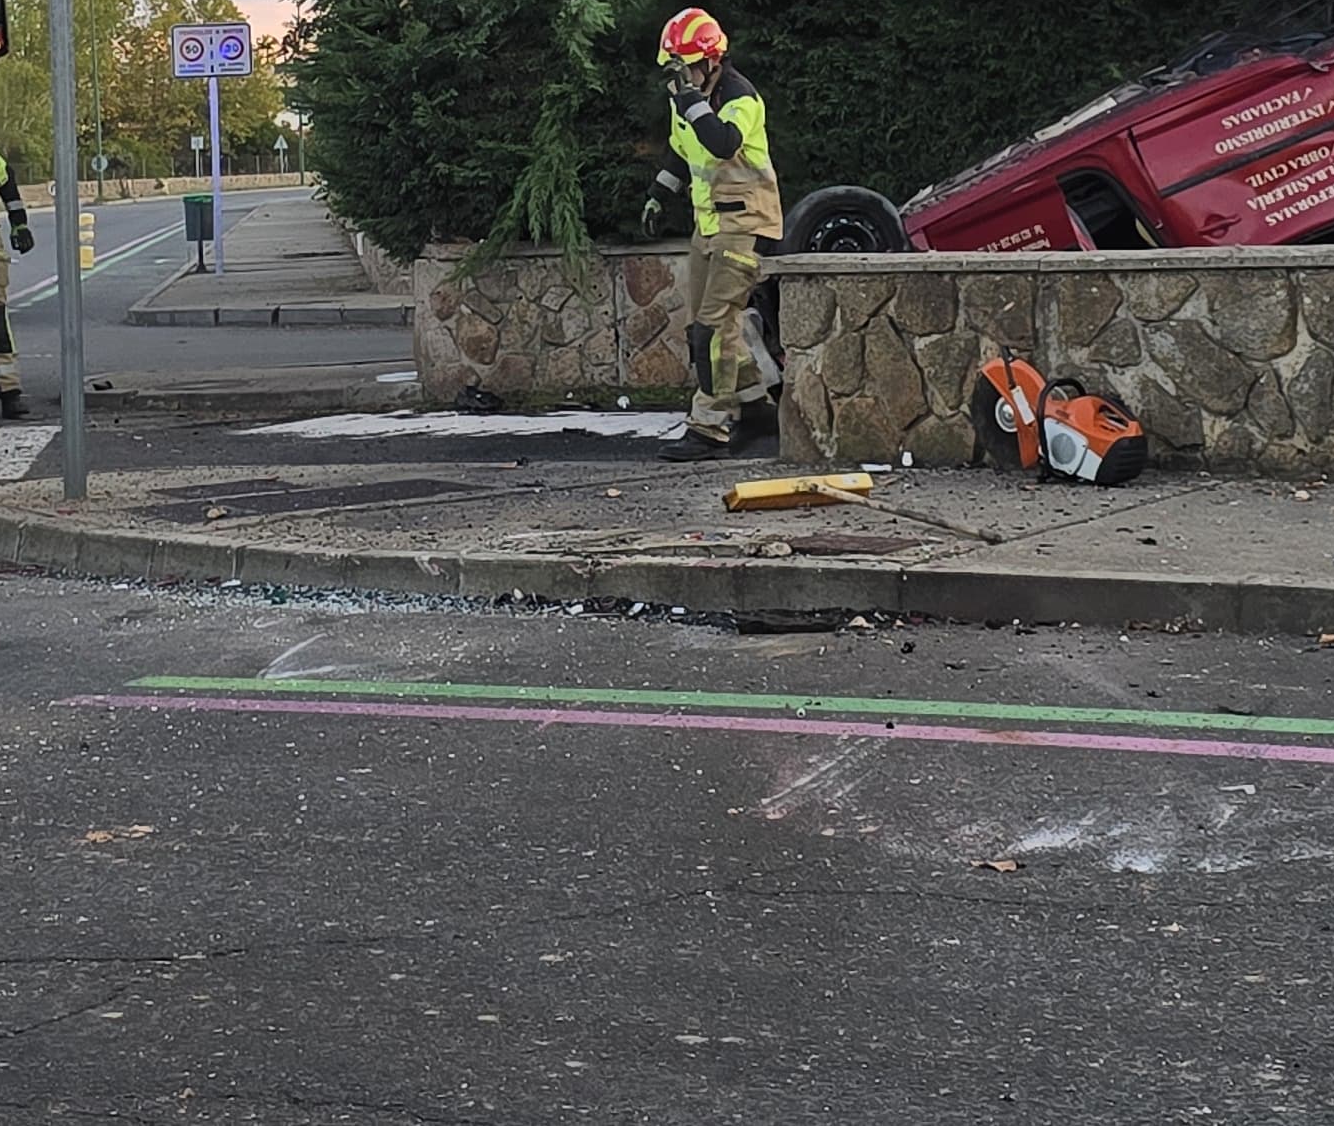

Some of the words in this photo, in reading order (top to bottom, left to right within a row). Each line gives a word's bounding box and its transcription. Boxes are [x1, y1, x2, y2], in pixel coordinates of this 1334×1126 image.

[1221, 90, 1301, 129] FACHADAS
[1215, 103, 1326, 154] INTERIORISMO
[1287, 145, 1330, 170] OBRA
[1244, 163, 1288, 188] CIVIL
